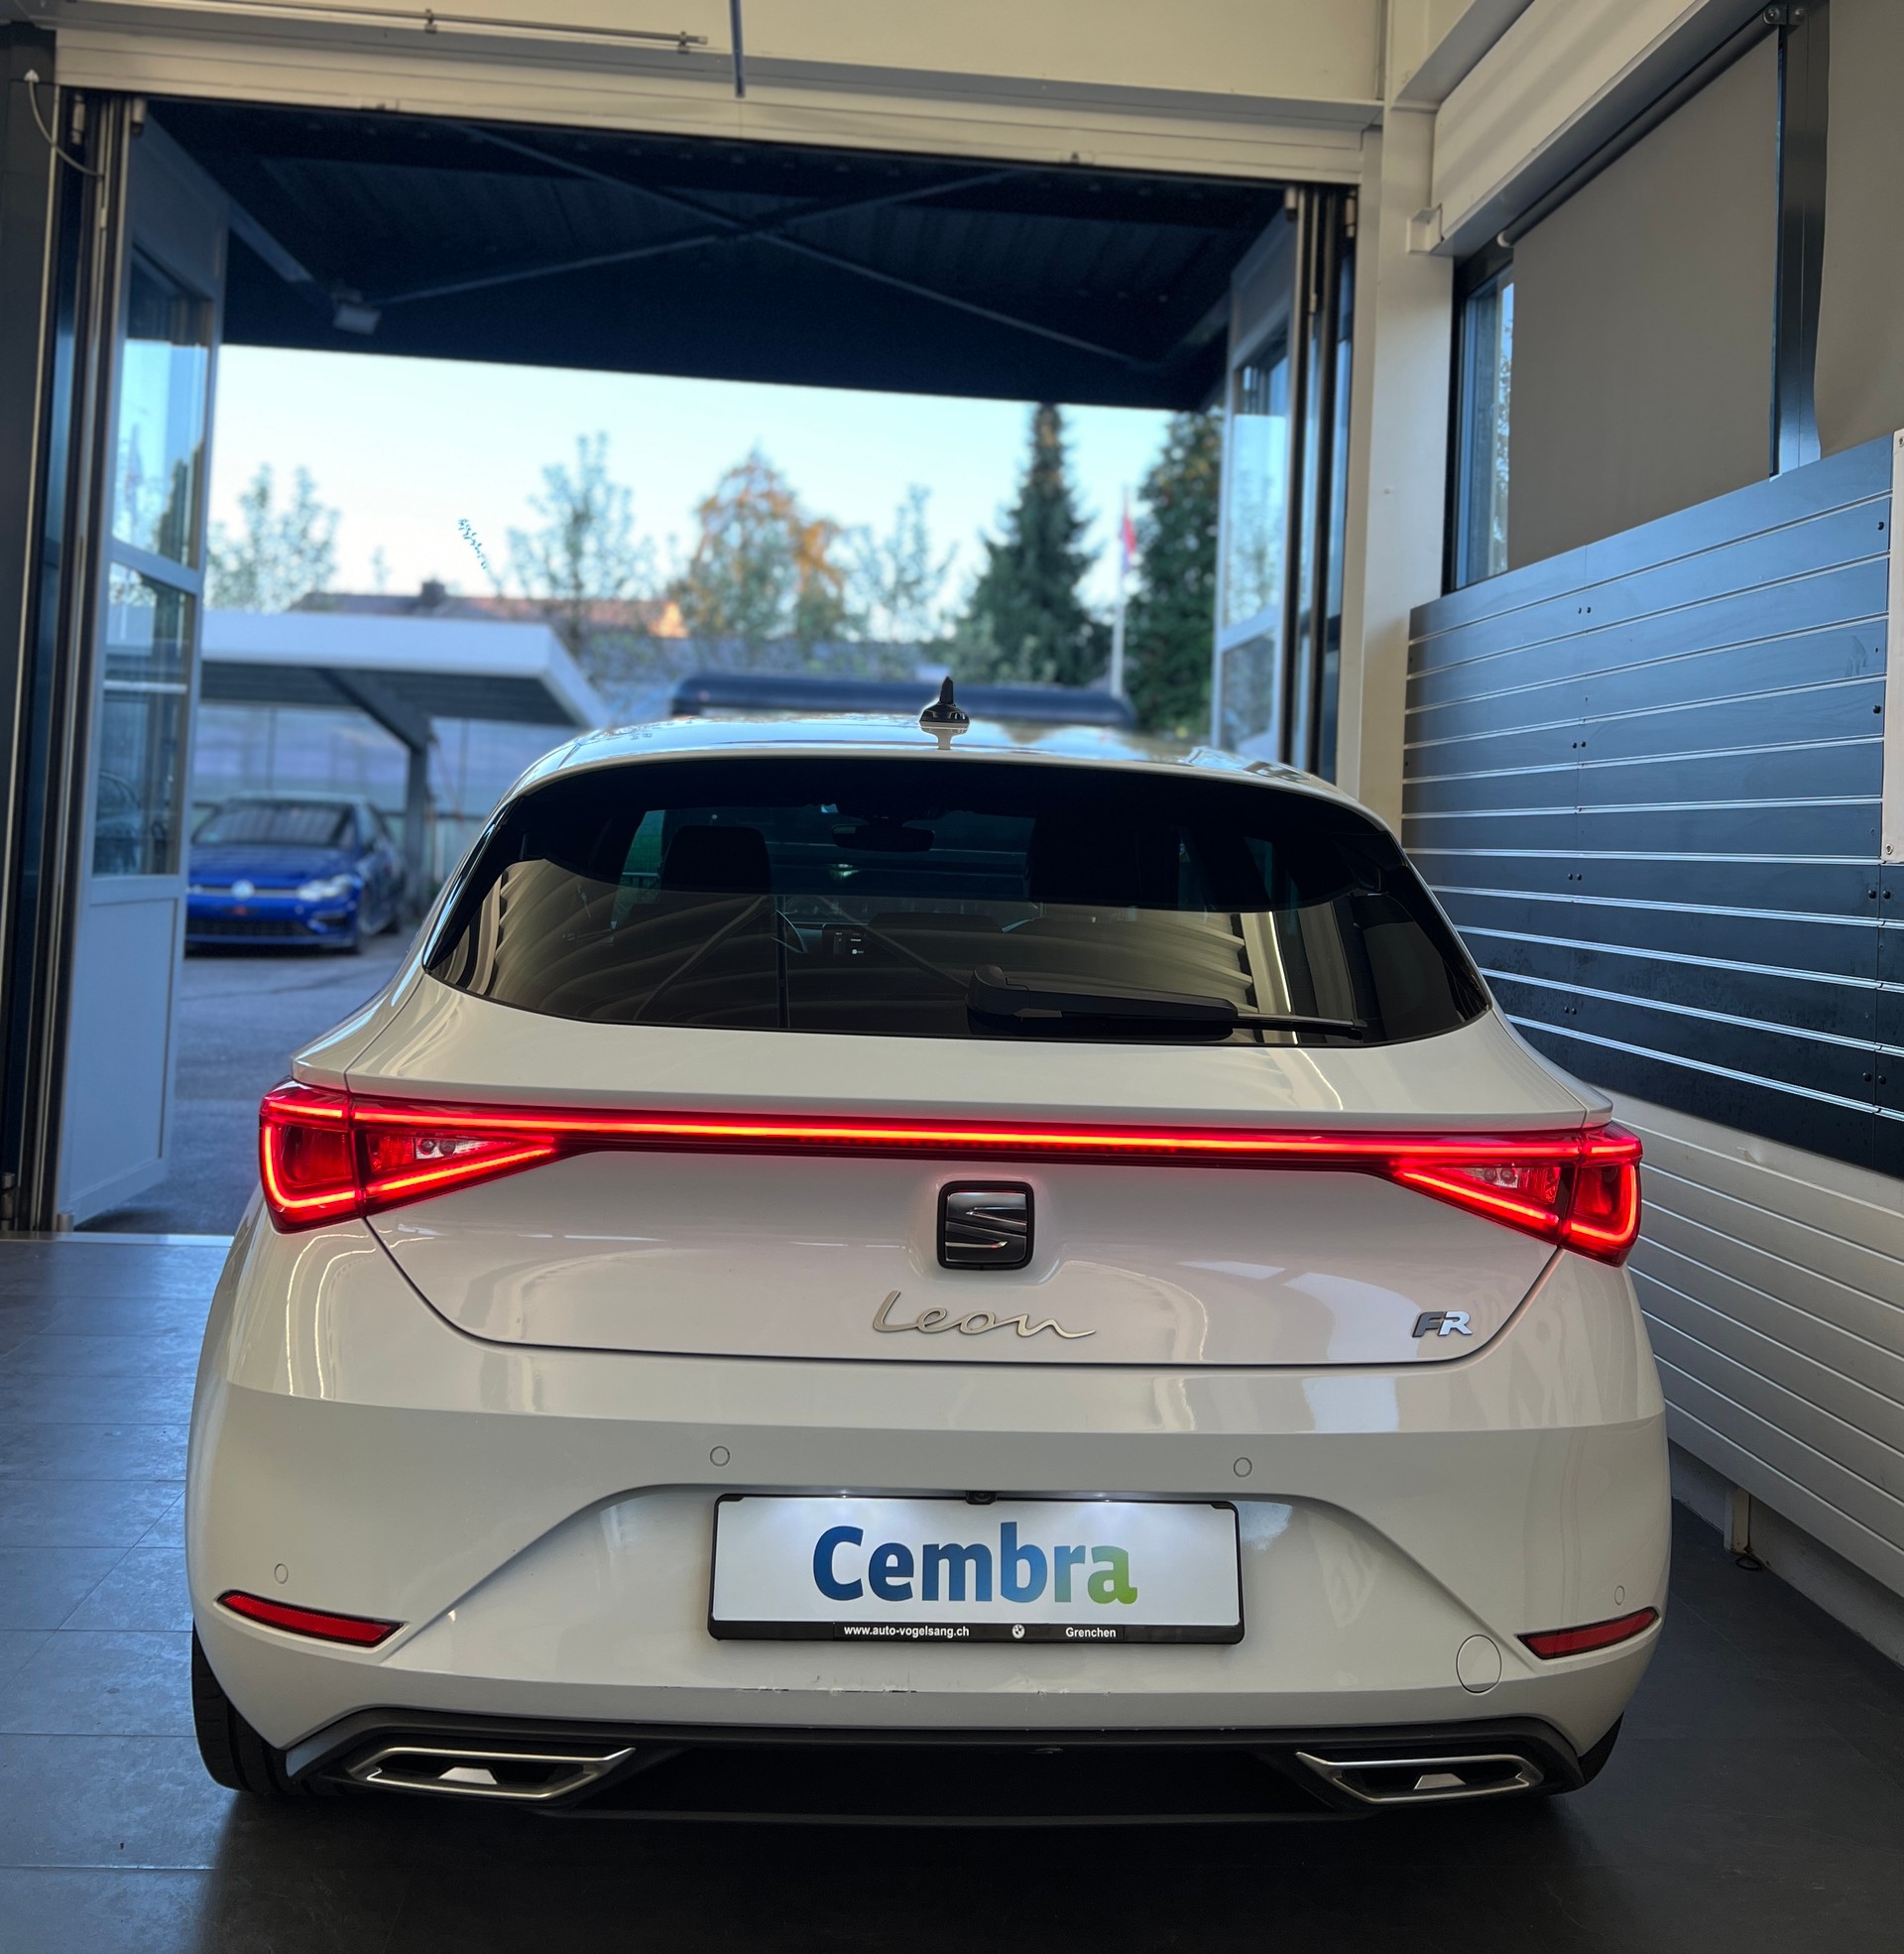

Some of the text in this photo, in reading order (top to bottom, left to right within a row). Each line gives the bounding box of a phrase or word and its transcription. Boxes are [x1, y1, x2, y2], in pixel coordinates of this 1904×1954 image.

[872, 1289, 1097, 1339] Leon
[1411, 1310, 1474, 1338] FR
[812, 1522, 1138, 1605] Cembra
[843, 1625, 1117, 1639] www.auto-vogelsang.ch Grenchen
